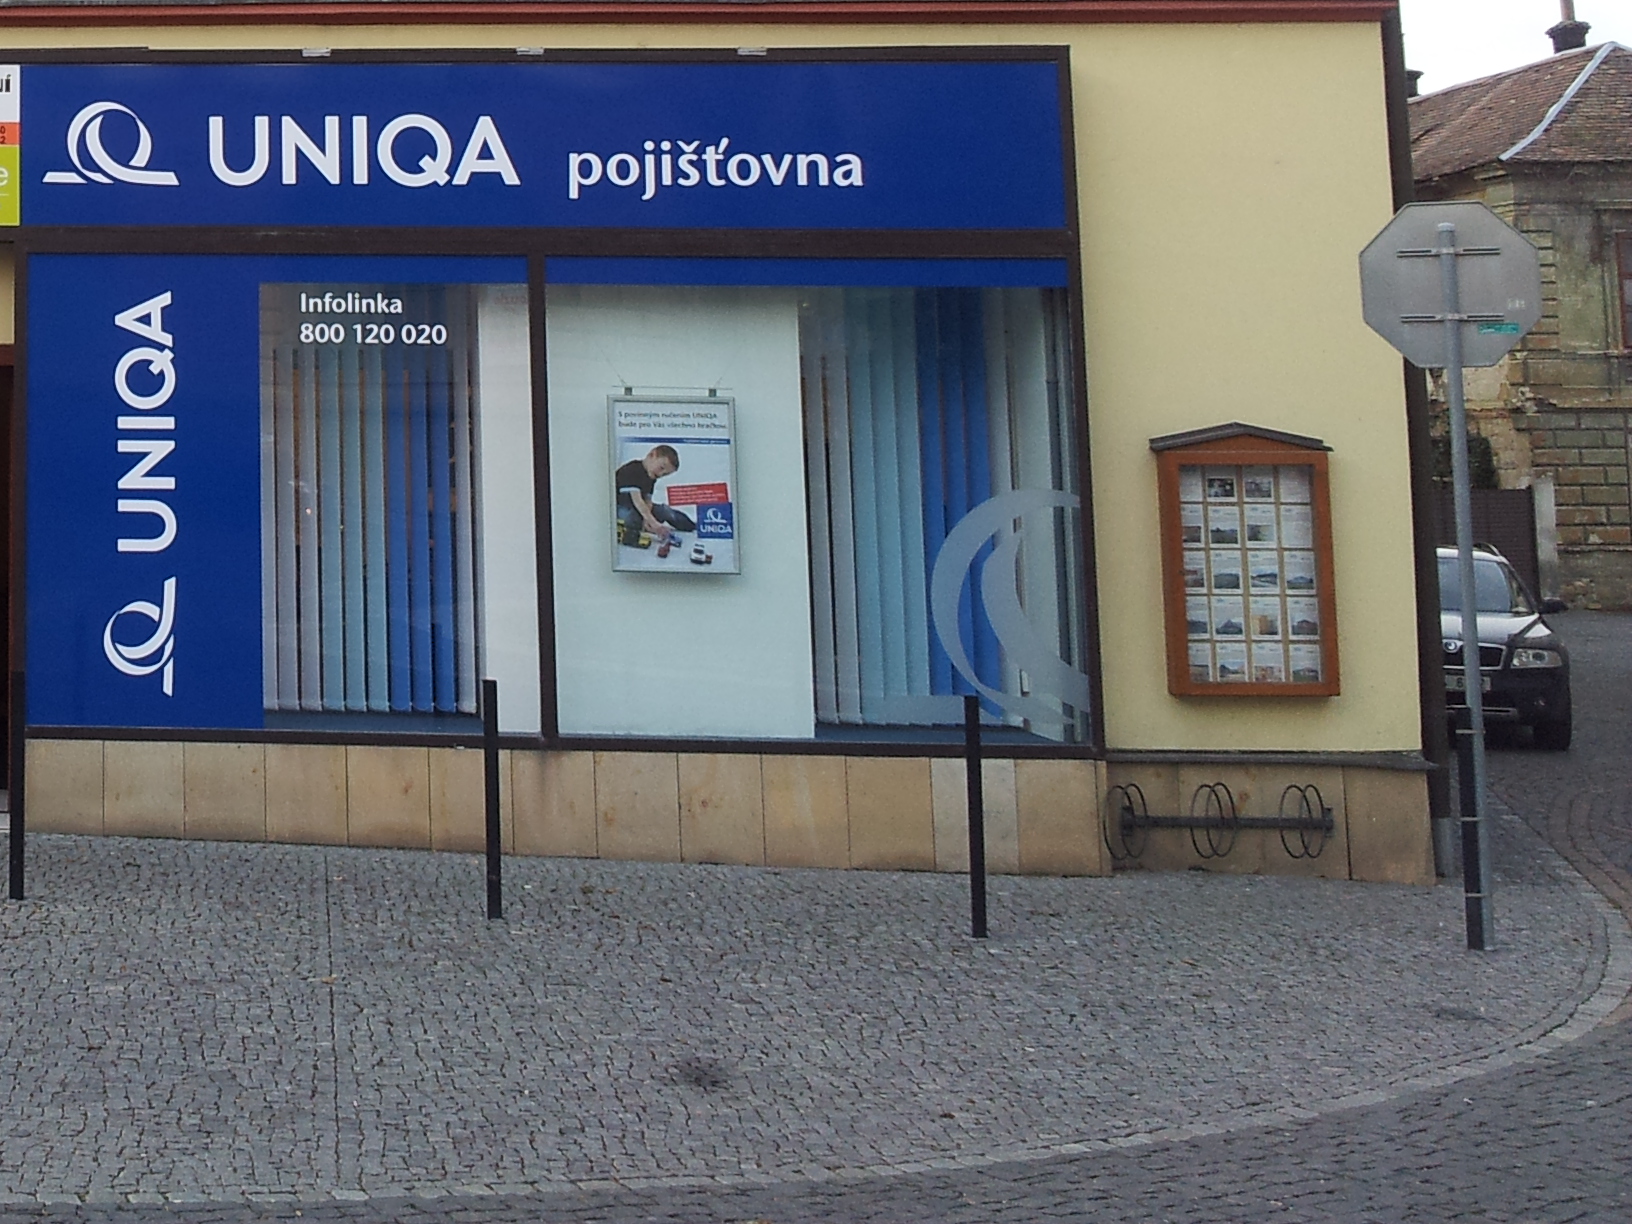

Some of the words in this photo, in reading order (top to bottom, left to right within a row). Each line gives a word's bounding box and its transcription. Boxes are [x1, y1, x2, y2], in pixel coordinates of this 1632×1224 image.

[208, 113, 521, 187] UNIQA
[568, 137, 864, 200] pojišťovna
[299, 292, 403, 314] Infolinka
[299, 323, 345, 344] 800
[353, 323, 396, 344] 120
[401, 323, 447, 344] 020
[114, 291, 177, 553] UNIQA
[700, 525, 732, 533] UNIQA
